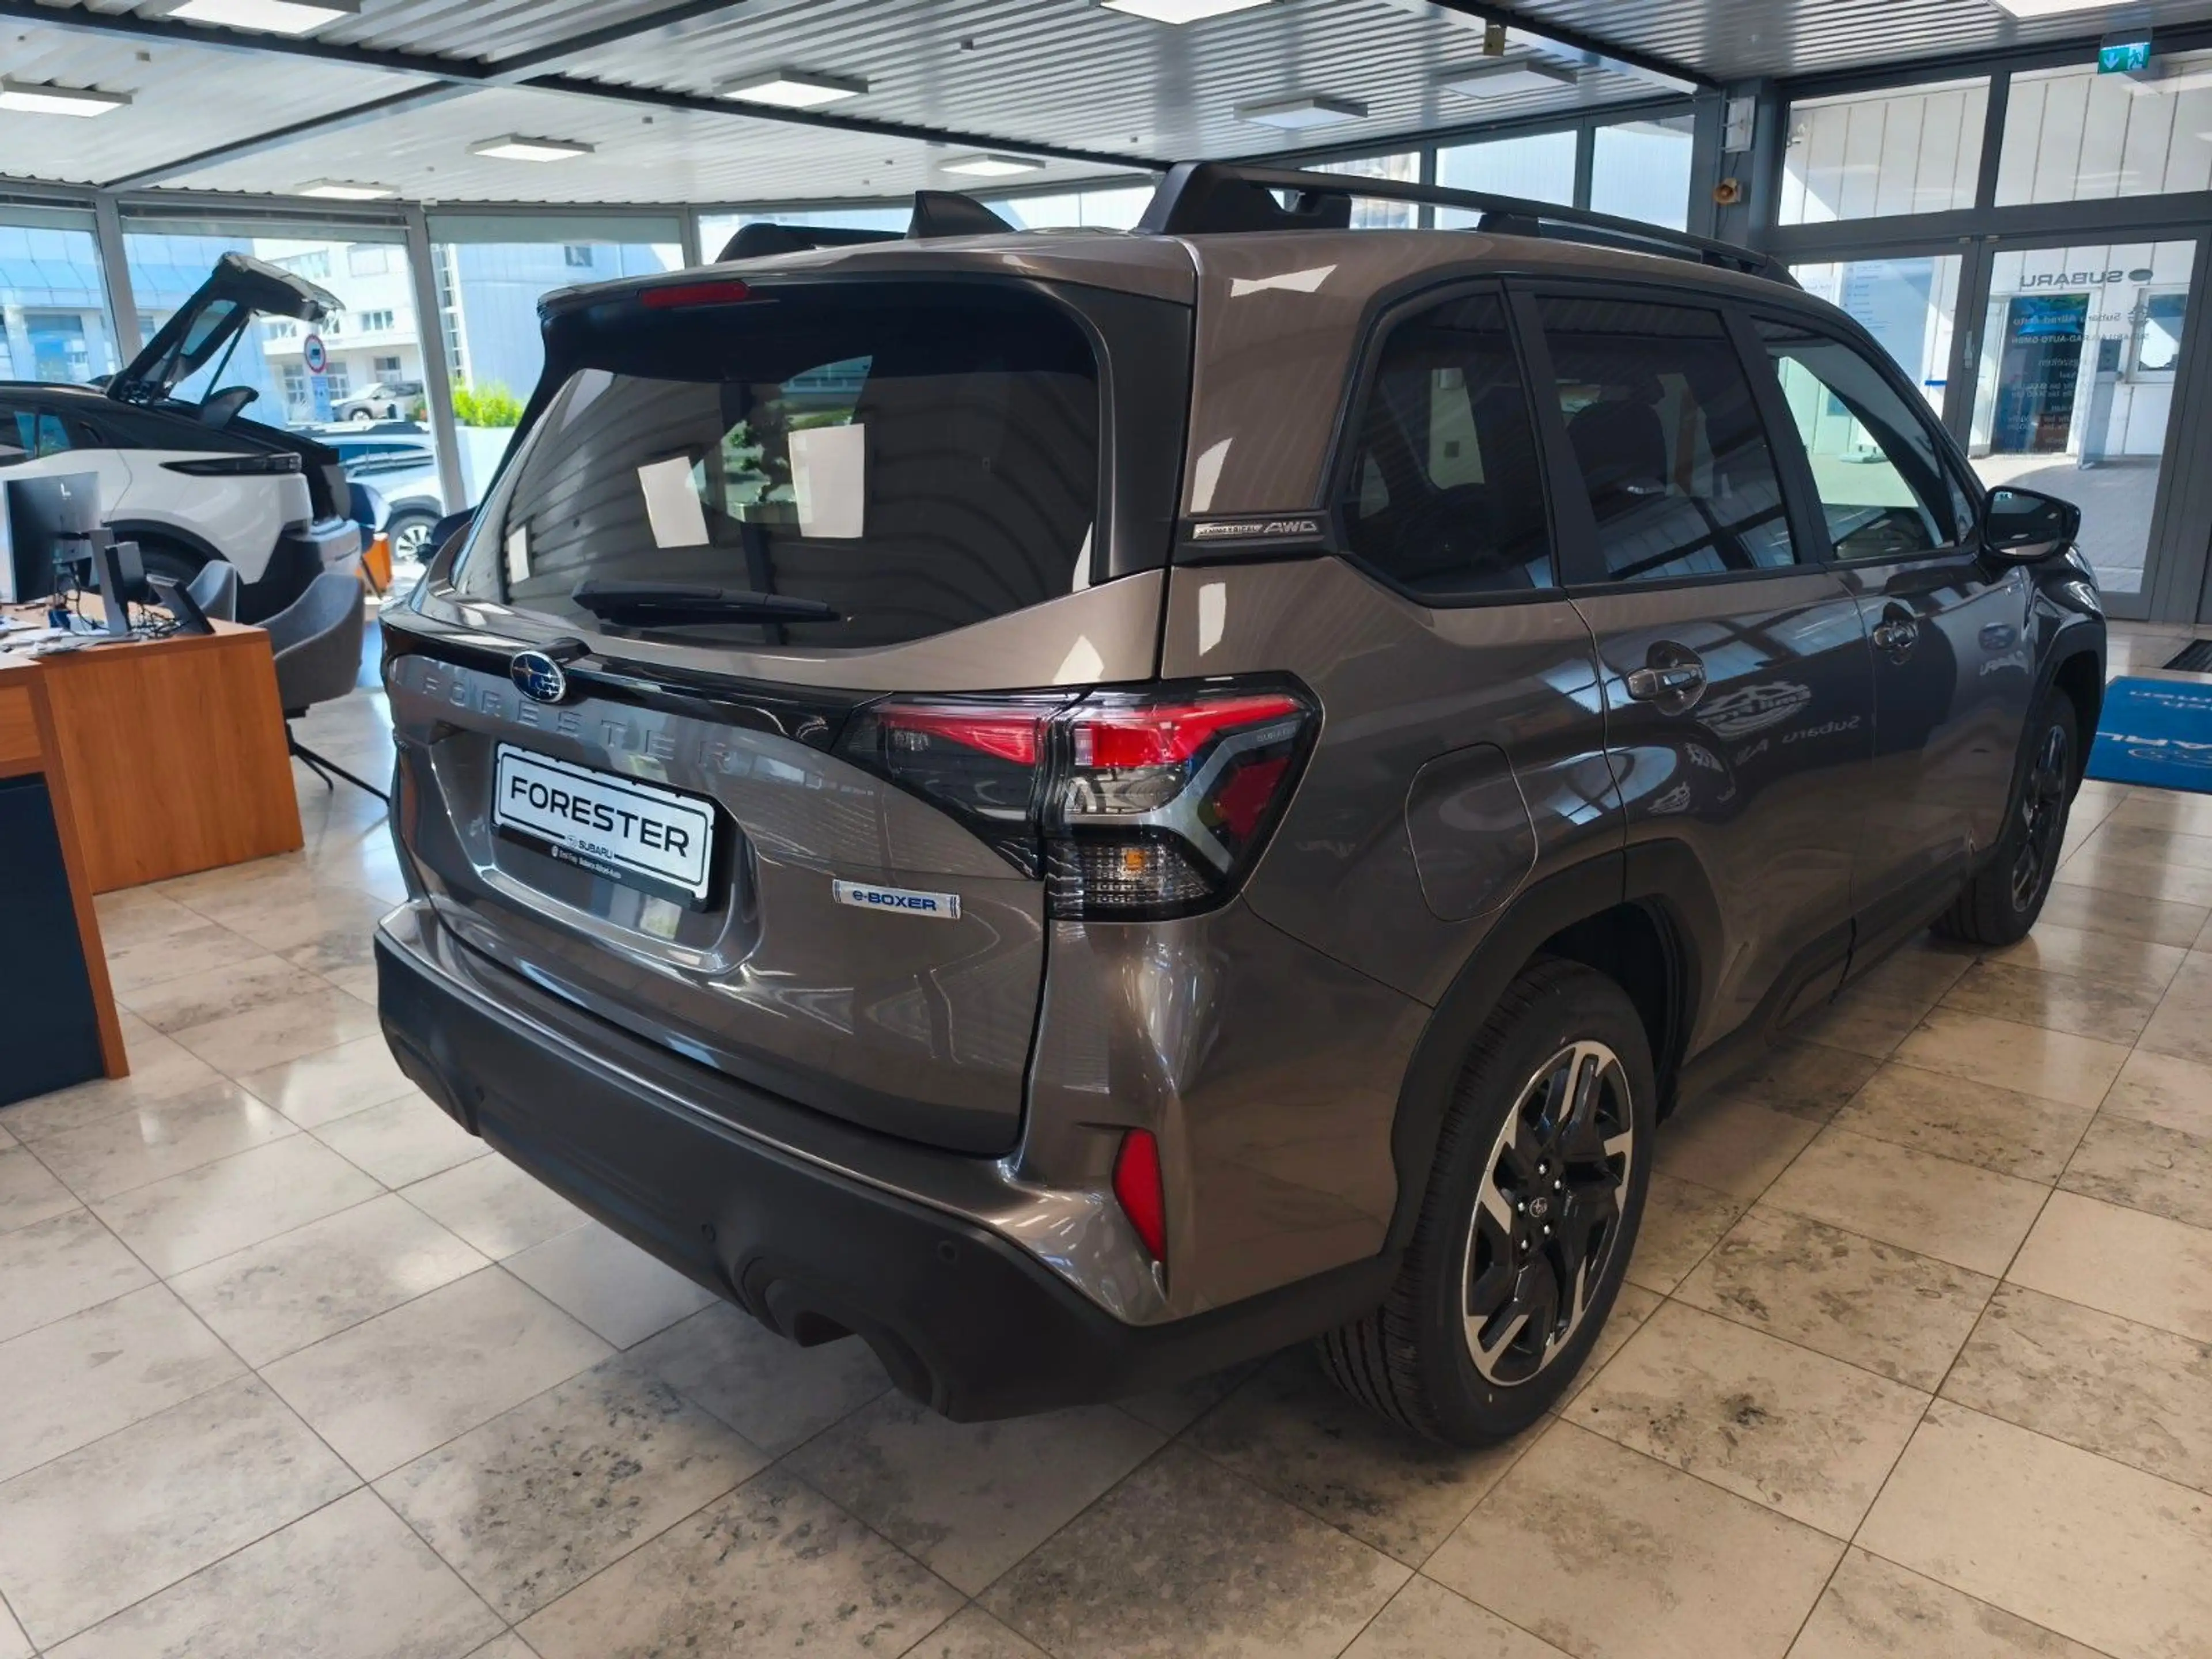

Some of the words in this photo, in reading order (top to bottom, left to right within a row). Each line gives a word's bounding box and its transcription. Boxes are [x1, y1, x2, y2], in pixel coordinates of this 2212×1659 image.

[1263, 520, 1317, 533] AWD
[422, 676, 728, 768] FORESTER
[510, 775, 690, 858] FORESTER
[578, 839, 613, 859] SUBARU
[852, 890, 937, 911] e-BOXER
